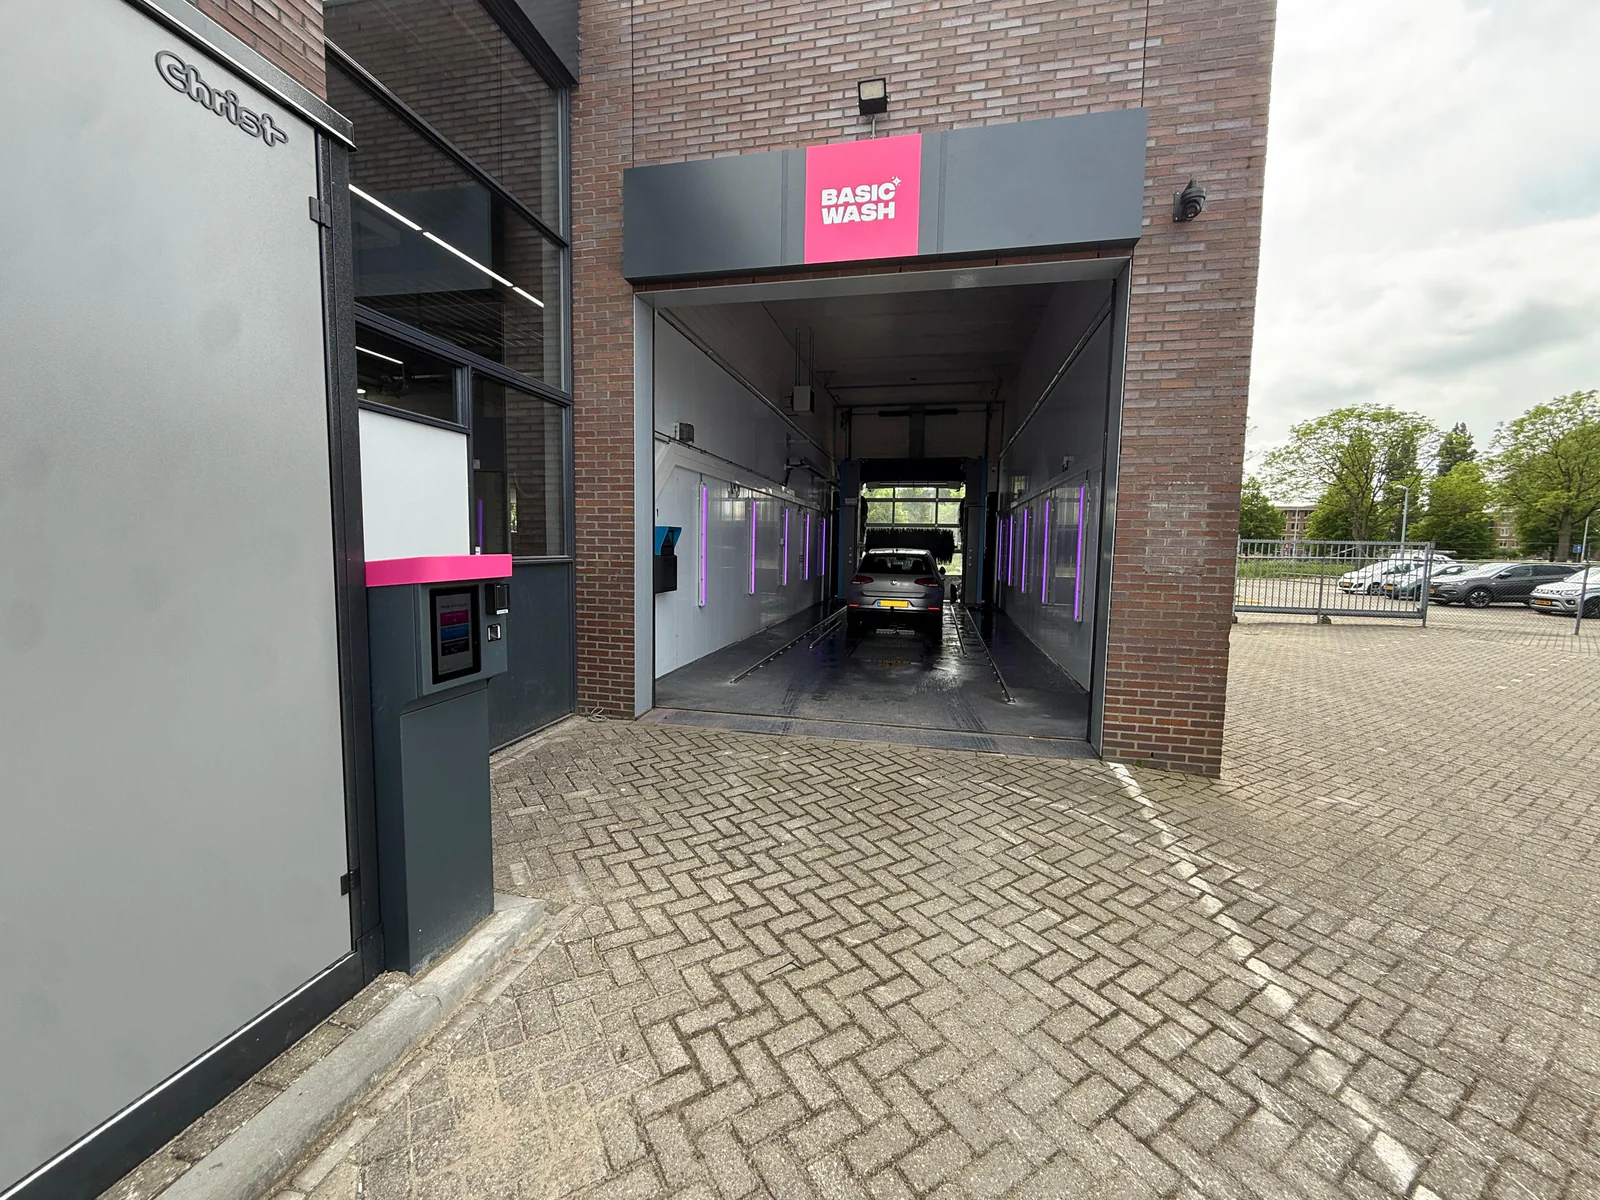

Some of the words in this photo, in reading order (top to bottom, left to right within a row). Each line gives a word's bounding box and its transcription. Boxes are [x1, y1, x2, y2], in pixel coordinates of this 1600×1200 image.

[155, 50, 289, 147] Christ
[821, 182, 896, 206] BASIC
[821, 201, 896, 225] WASH
